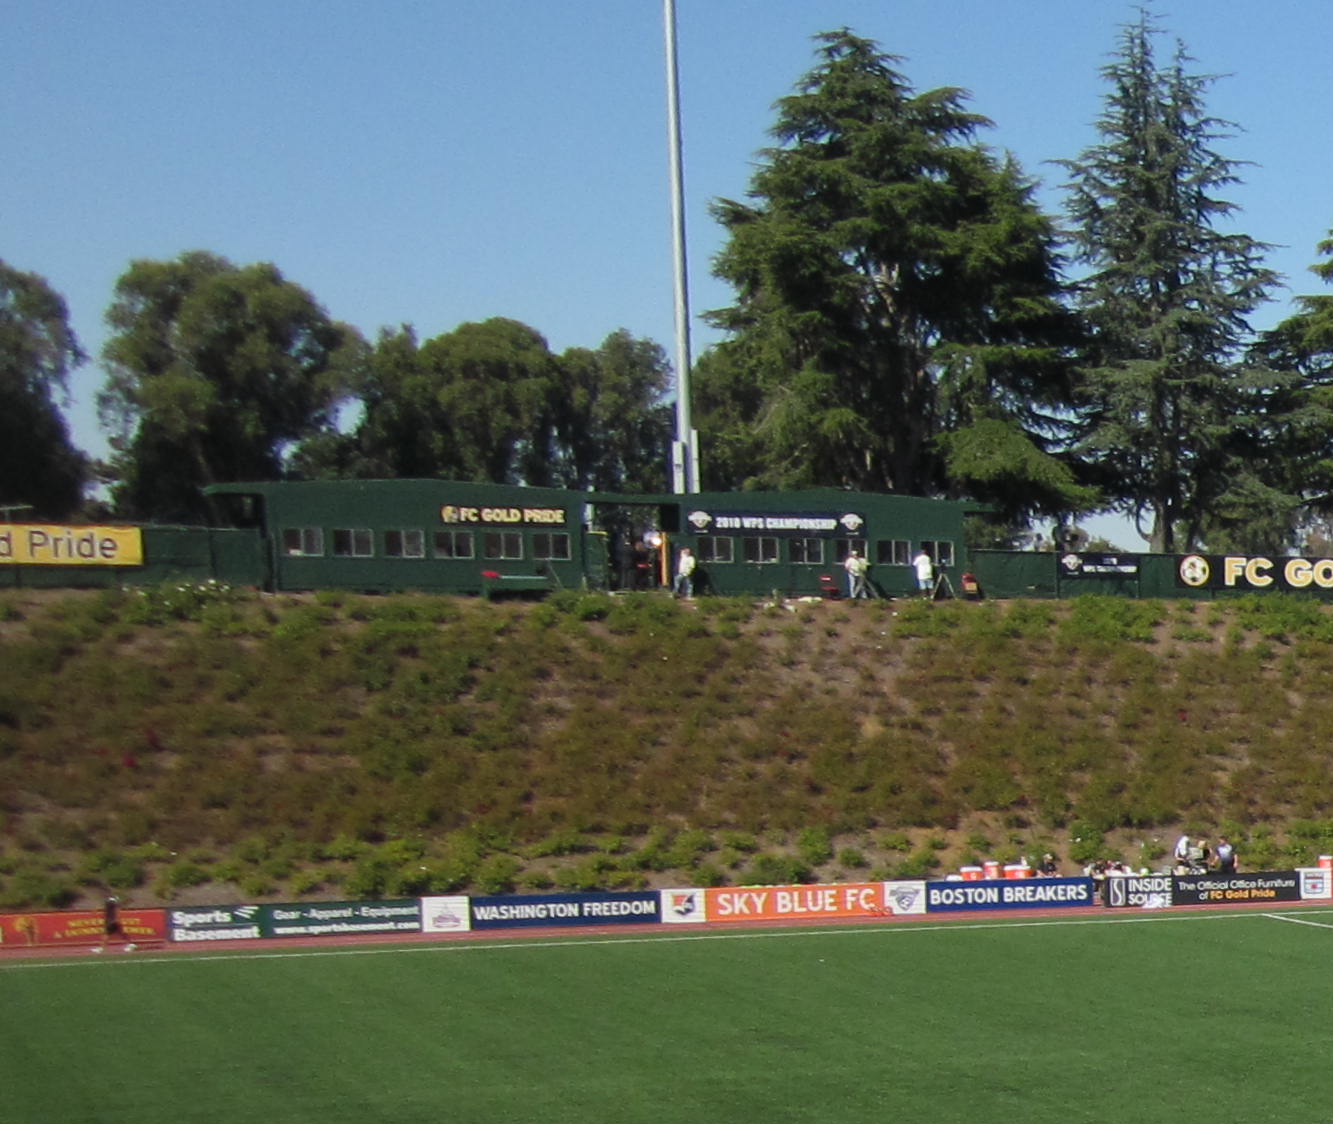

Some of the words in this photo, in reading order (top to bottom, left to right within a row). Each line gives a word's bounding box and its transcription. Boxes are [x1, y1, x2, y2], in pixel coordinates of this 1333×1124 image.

[460, 508, 479, 522] FC
[481, 508, 521, 523] GOLD
[524, 509, 565, 523] PRIDE
[766, 518, 837, 530] CHAMPIONSHIP
[28, 530, 118, 558] Pride
[1224, 556, 1274, 588] FC
[1128, 878, 1172, 891] INSIDE
[1179, 881, 1195, 891] The
[1197, 880, 1228, 891] Official
[1231, 879, 1256, 890] Office
[718, 892, 768, 915] SKY
[776, 890, 837, 913] BLUE
[846, 888, 875, 910] FC
[930, 888, 998, 905] BOSTON
[1003, 884, 1087, 902] BREAKERS
[1210, 891, 1223, 900] FC
[1226, 889, 1249, 899] Gold
[1251, 888, 1276, 898] Pride
[474, 903, 579, 920] WASHINGTON
[583, 900, 656, 917] FREEDOM
[171, 911, 231, 926] Sports
[173, 926, 260, 941] Basement
